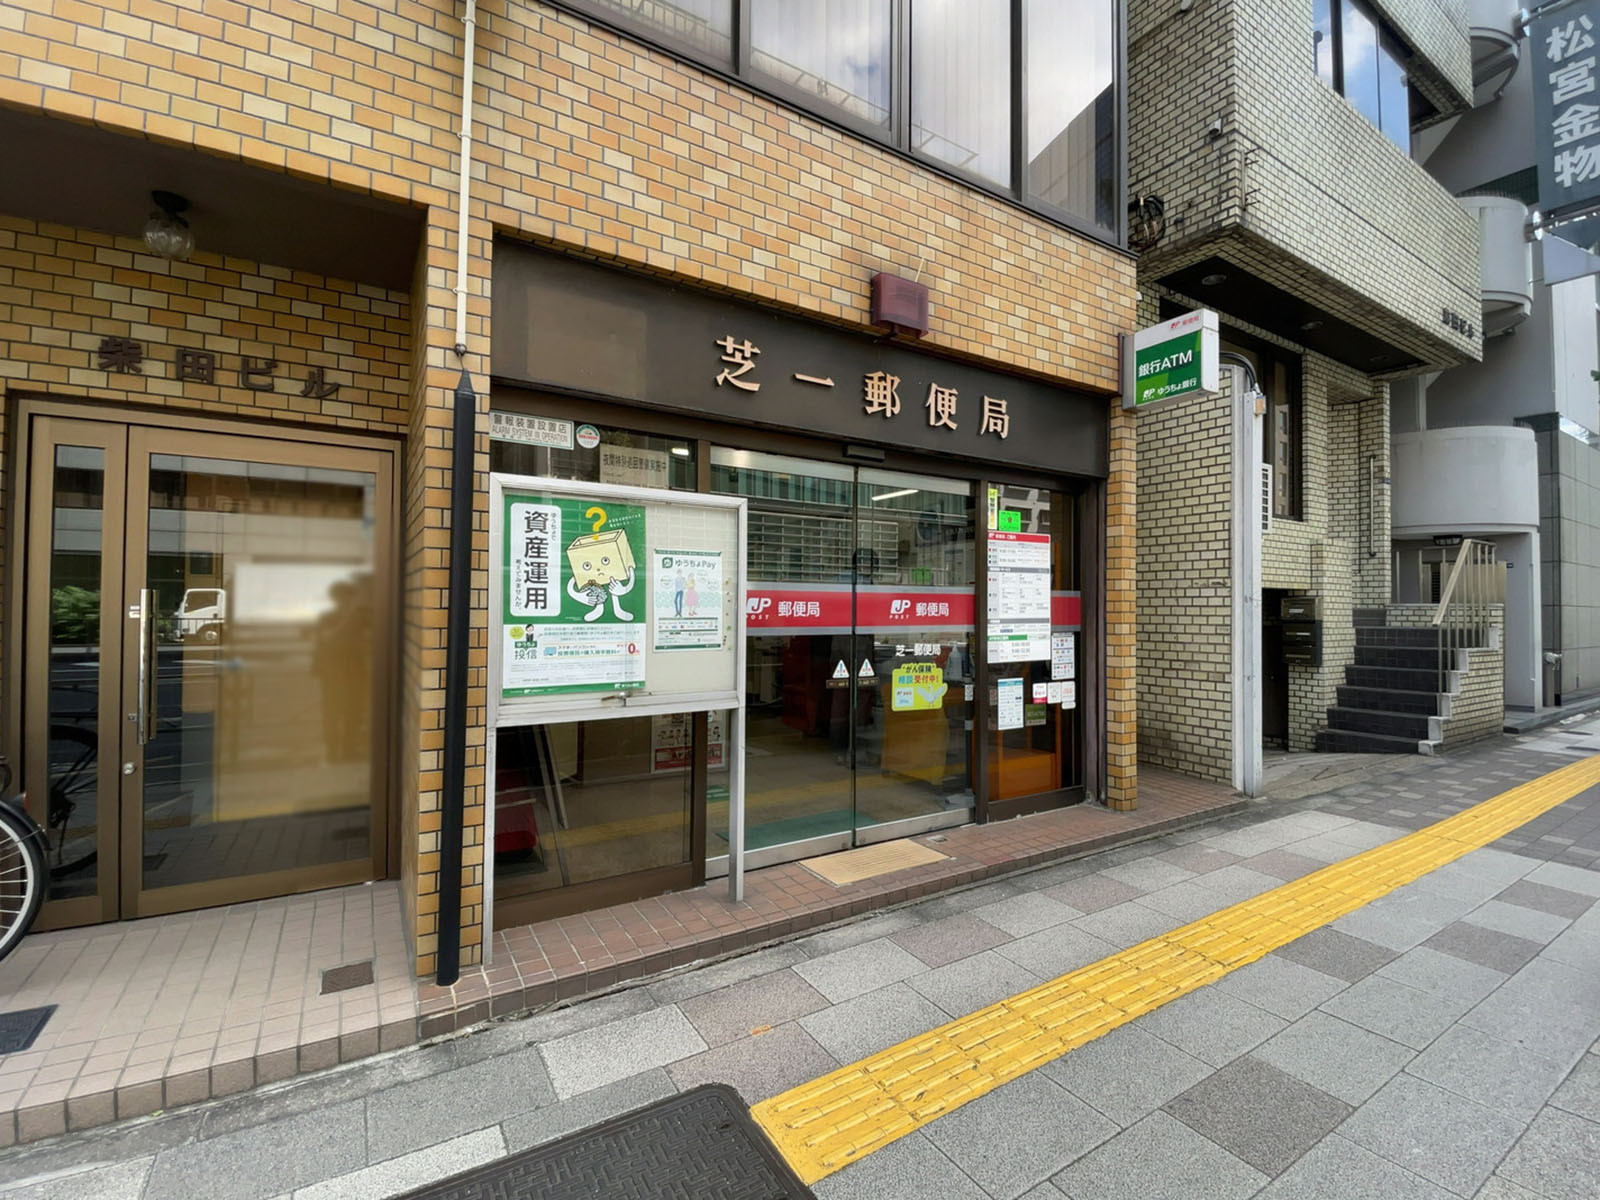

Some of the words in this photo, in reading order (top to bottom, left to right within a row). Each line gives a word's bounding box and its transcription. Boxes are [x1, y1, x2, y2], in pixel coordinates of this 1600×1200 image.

[1545, 15, 1600, 190] 松宮金物
[1138, 349, 1193, 378] 銀行ATM
[715, 335, 1011, 441] 芝一郵便局
[1157, 377, 1198, 396] ゆうちょ銀行
[523, 510, 549, 610] 資産運用
[675, 558, 716, 569] ゆうちょPay
[778, 601, 820, 617] 郵便局
[916, 602, 949, 616] 郵便局
[514, 649, 537, 660] 投信
[895, 643, 941, 656] 芝一郵便局
